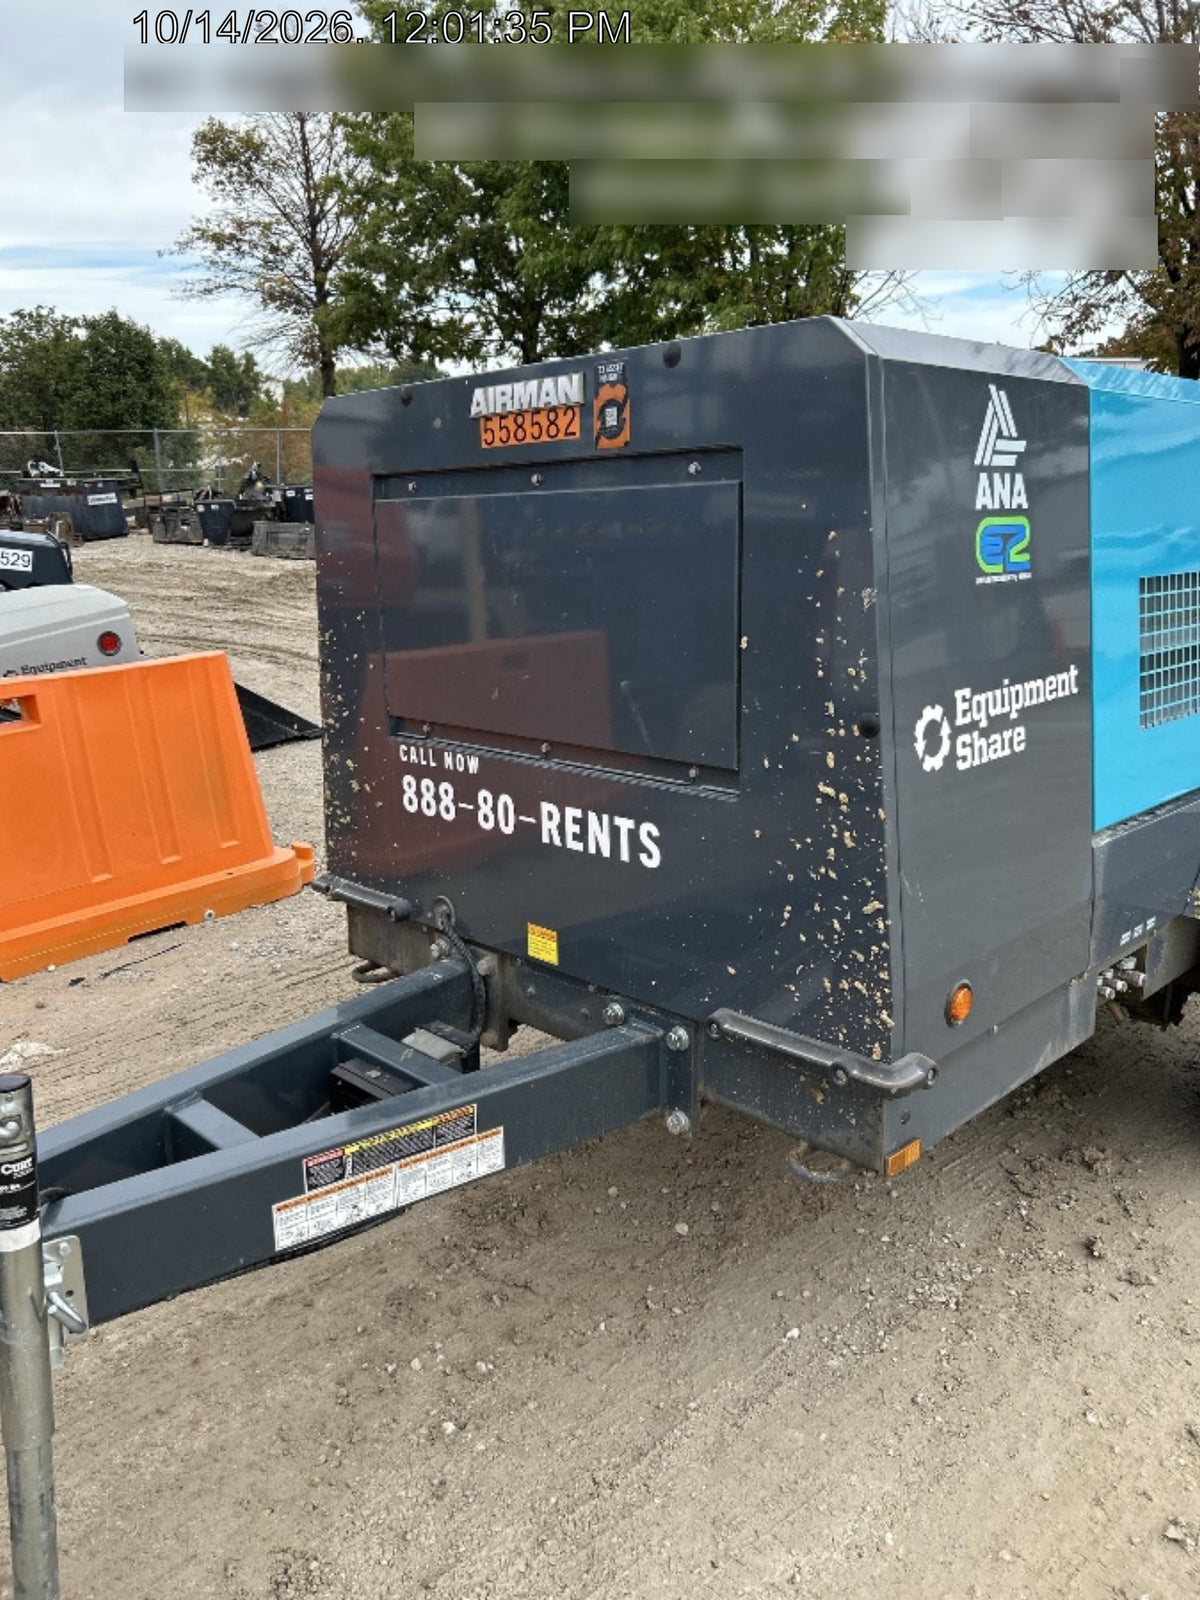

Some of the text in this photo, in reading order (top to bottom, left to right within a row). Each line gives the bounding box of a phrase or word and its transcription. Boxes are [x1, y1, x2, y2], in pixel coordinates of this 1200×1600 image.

[470, 371, 584, 419] AIRMAN
[483, 407, 576, 446] 558582
[975, 473, 1029, 510] ANA
[21, 656, 87, 676] Equipment
[954, 664, 1079, 728] Equipment
[399, 744, 479, 774] CALL NOW
[955, 726, 1027, 771] Share
[402, 774, 662, 869] 888-80-RENTS
